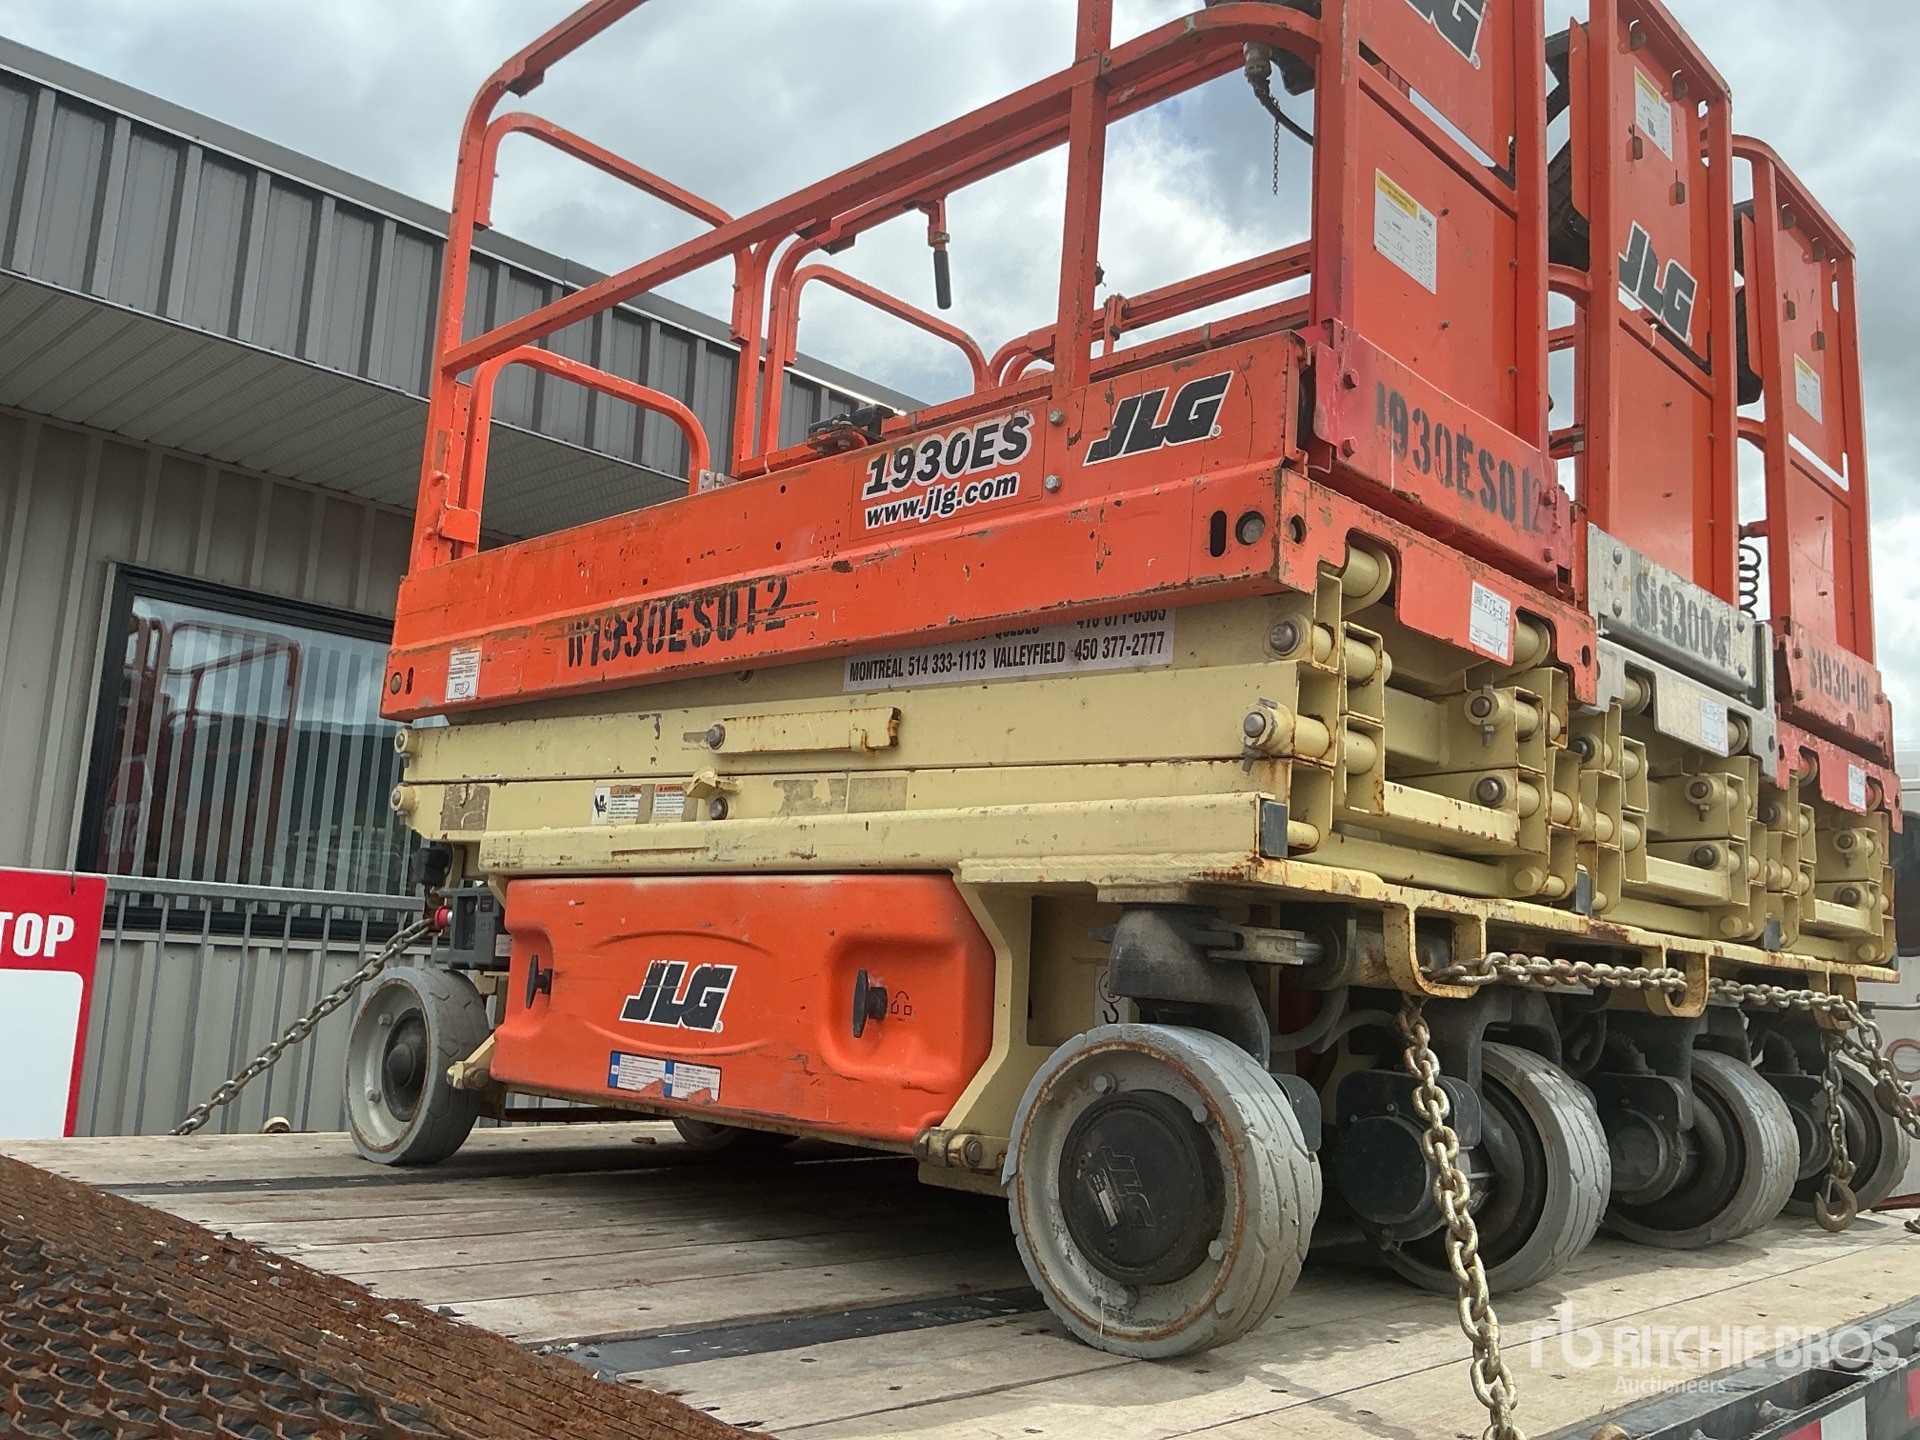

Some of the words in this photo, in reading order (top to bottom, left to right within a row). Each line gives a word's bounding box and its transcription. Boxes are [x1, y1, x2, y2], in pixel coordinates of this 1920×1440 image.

[1618, 220, 1697, 342] JLG
[864, 413, 1033, 497] 1930ES
[1085, 371, 1233, 466] JLG
[865, 474, 1018, 528] www.jlg.com
[849, 653, 904, 682] MONTRÉAL
[908, 654, 929, 676] 514
[932, 648, 987, 674] 333-1113
[993, 641, 1066, 668] VALLEYFIELD
[1074, 637, 1098, 661] 450
[1102, 631, 1165, 658] 377-2777
[619, 960, 737, 1031] JLG
